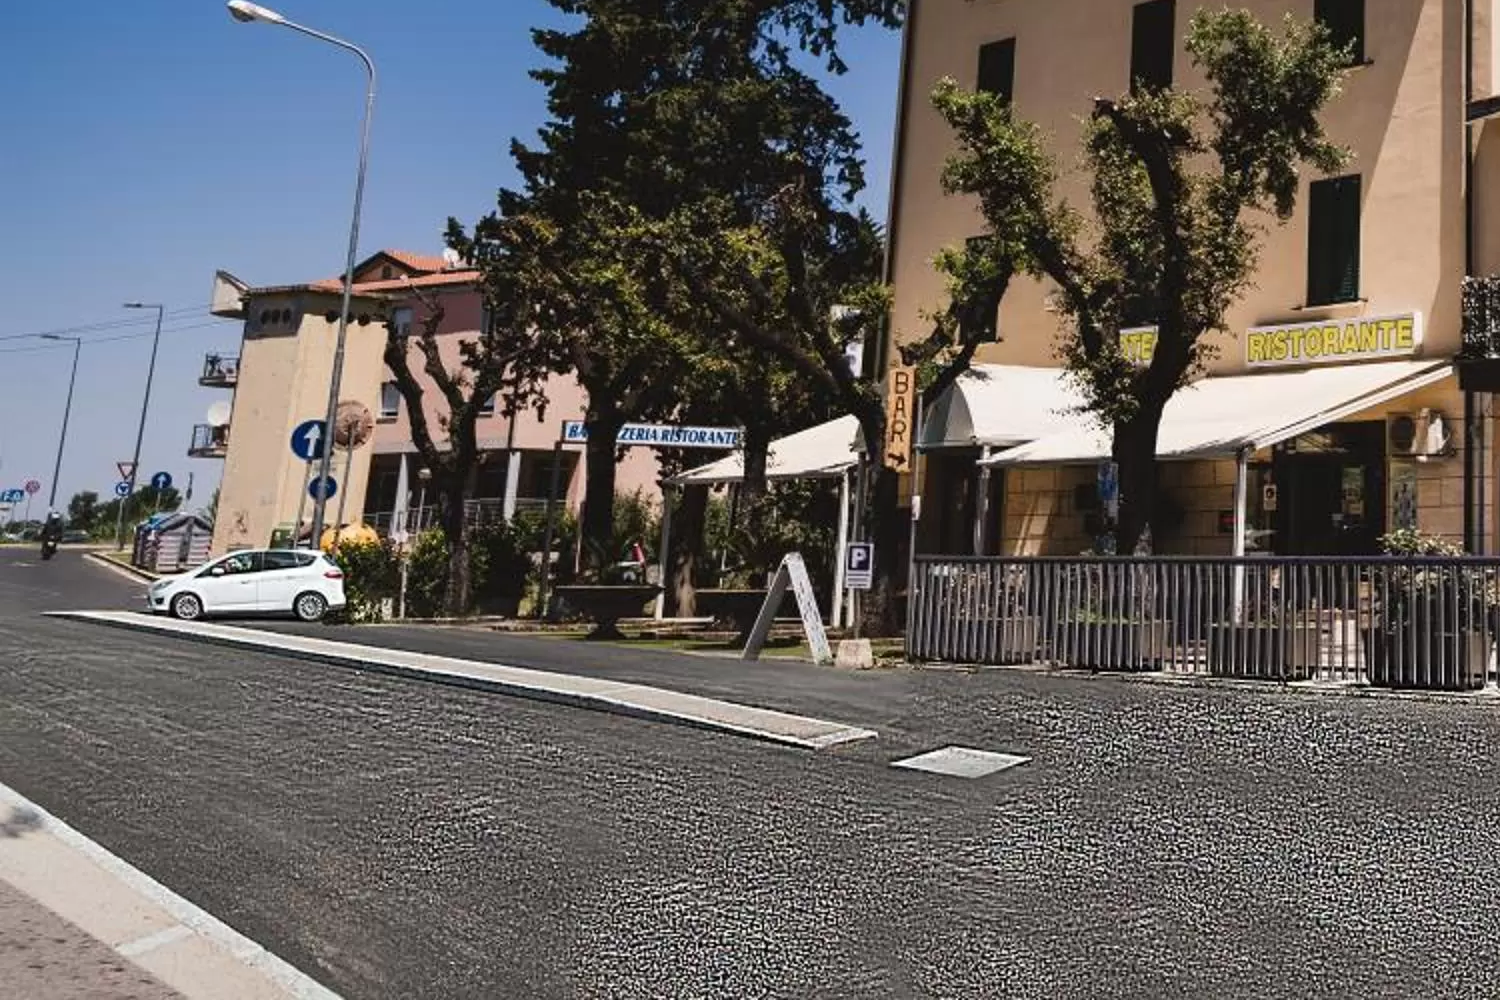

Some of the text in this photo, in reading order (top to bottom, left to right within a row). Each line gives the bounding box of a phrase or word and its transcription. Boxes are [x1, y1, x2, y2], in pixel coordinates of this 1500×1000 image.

[1247, 318, 1414, 362] RISTORANTE
[891, 371, 909, 442] BAR
[851, 547, 867, 568] P
